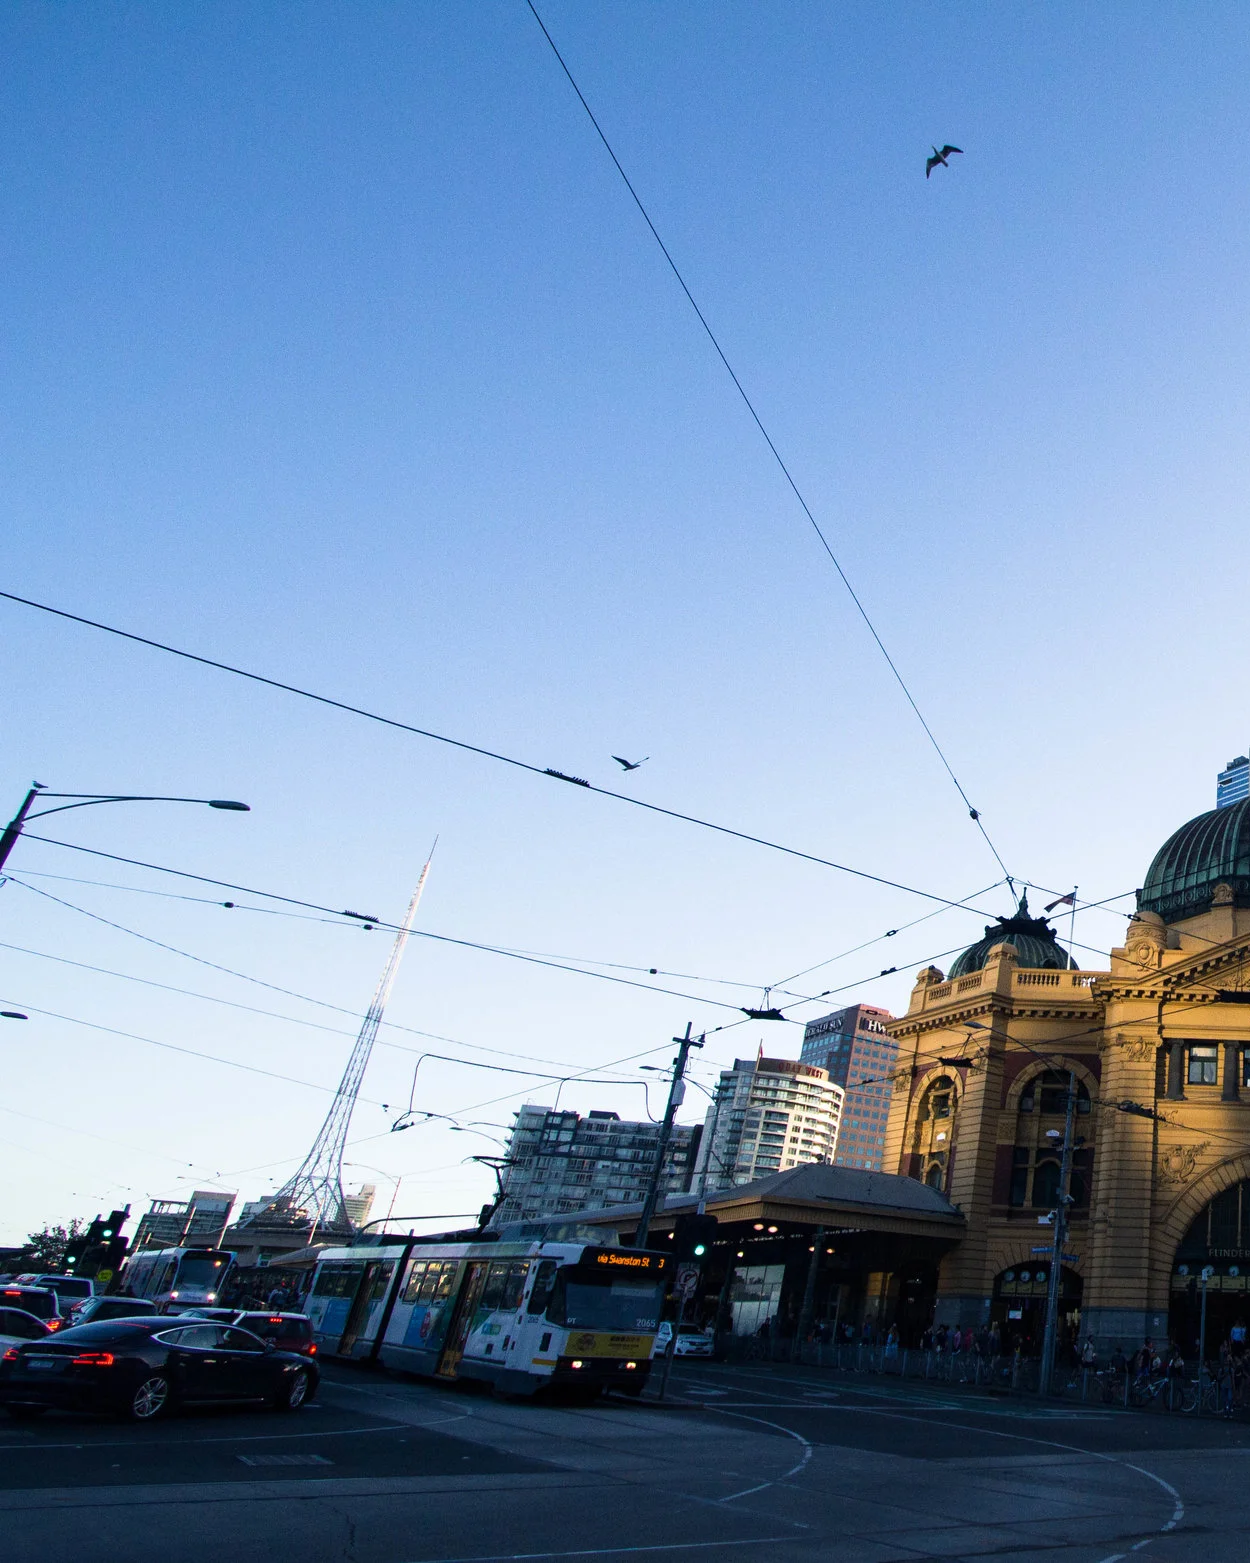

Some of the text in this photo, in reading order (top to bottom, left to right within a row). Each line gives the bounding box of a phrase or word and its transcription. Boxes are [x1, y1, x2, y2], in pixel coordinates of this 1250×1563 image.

[829, 1017, 844, 1030] SUN
[778, 1061, 824, 1079] QUAY WEST
[597, 1253, 665, 1269] via Swanston St 3
[636, 1318, 656, 1328] 2065
